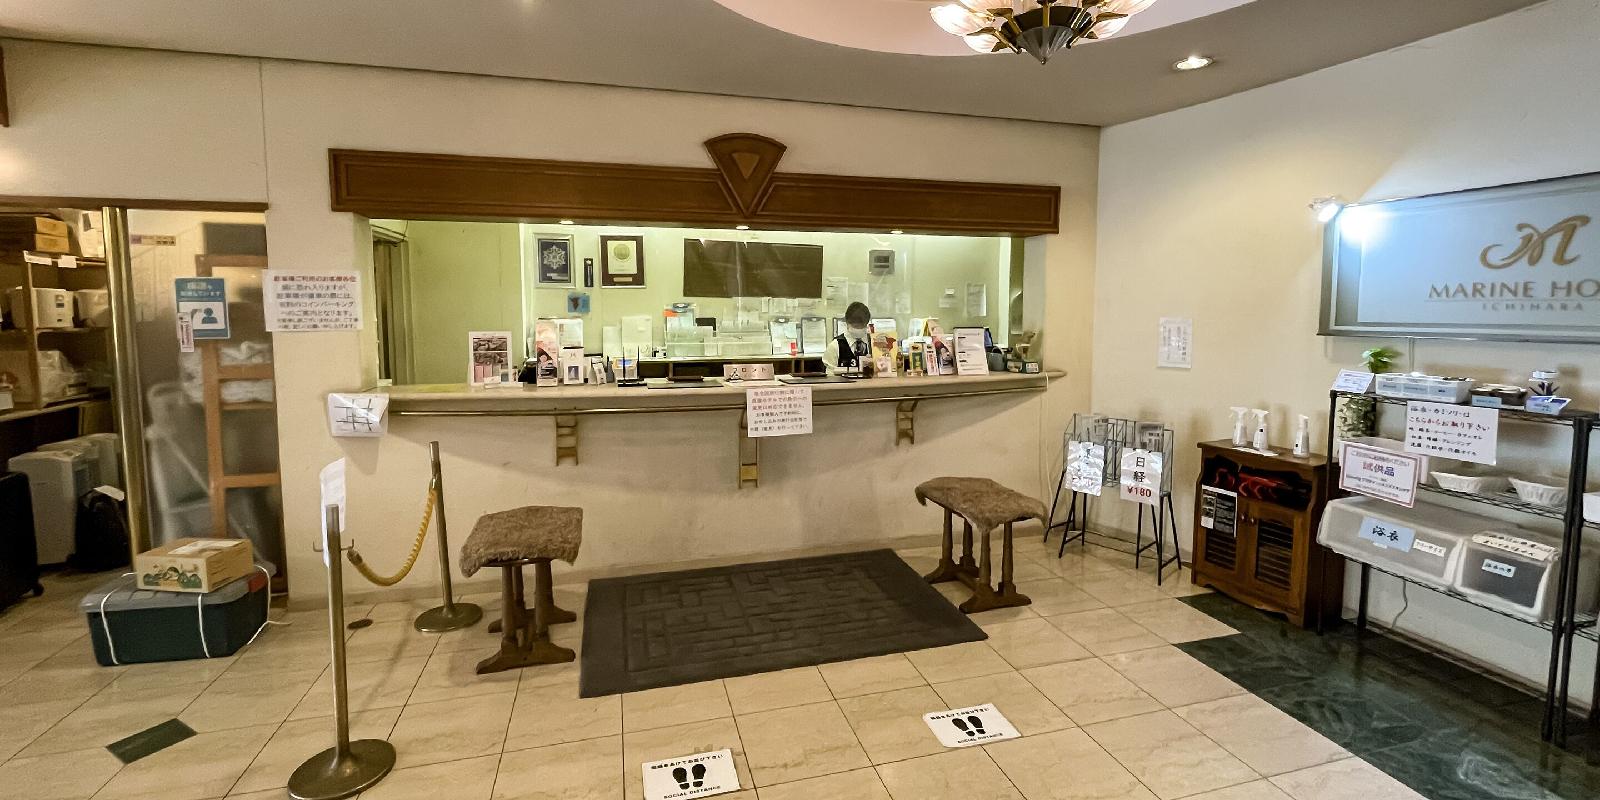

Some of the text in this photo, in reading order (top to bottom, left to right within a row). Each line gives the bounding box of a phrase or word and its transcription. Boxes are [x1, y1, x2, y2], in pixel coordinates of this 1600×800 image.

[1428, 281, 1536, 299] MARINE
[1482, 301, 1584, 311] ICHIHARA
[851, 359, 857, 367] 3
[1133, 456, 1146, 483] 日経
[1362, 460, 1396, 477] 試供品
[1372, 525, 1399, 541] 浴衣
[663, 785, 721, 799] SOCIAL DISTANCE
